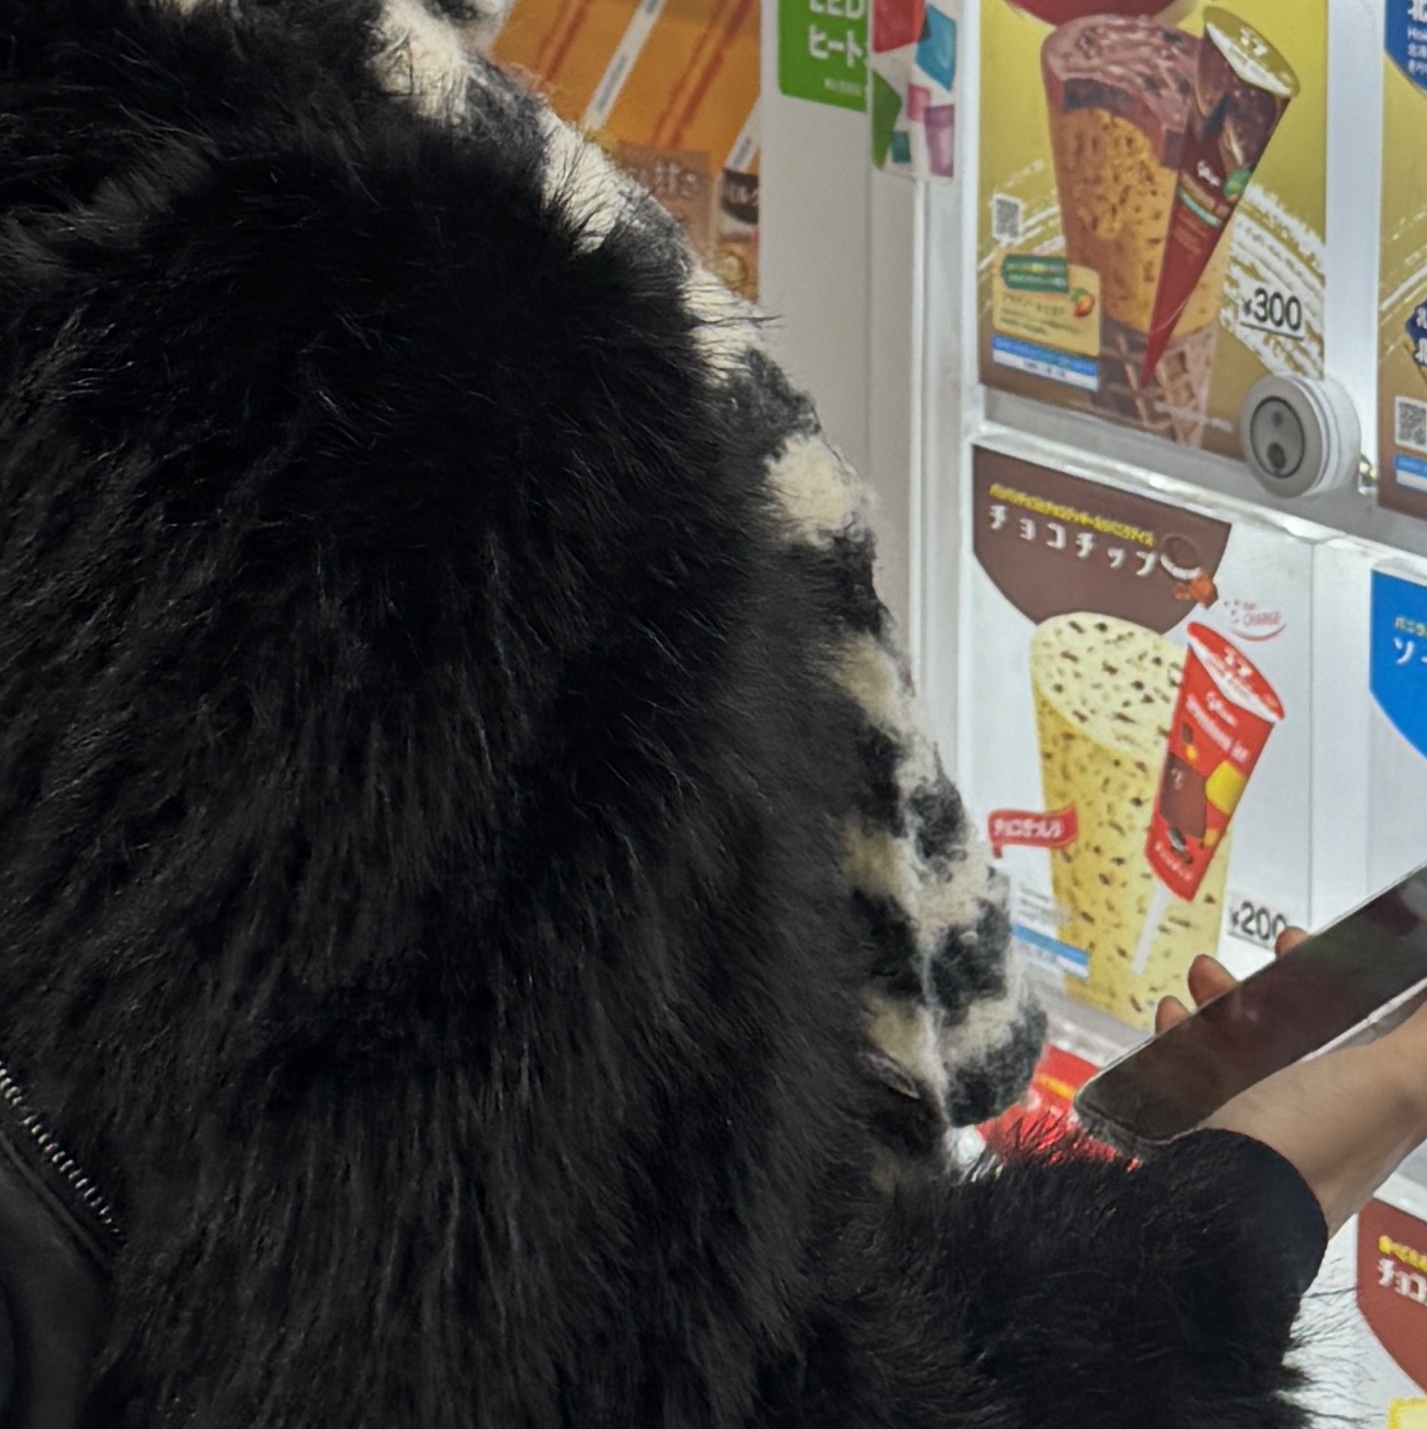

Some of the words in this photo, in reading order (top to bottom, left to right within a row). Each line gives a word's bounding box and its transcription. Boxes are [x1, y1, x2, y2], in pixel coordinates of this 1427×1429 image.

[1242, 288, 1302, 332] ¥300
[988, 504, 1158, 576] チョコチップ
